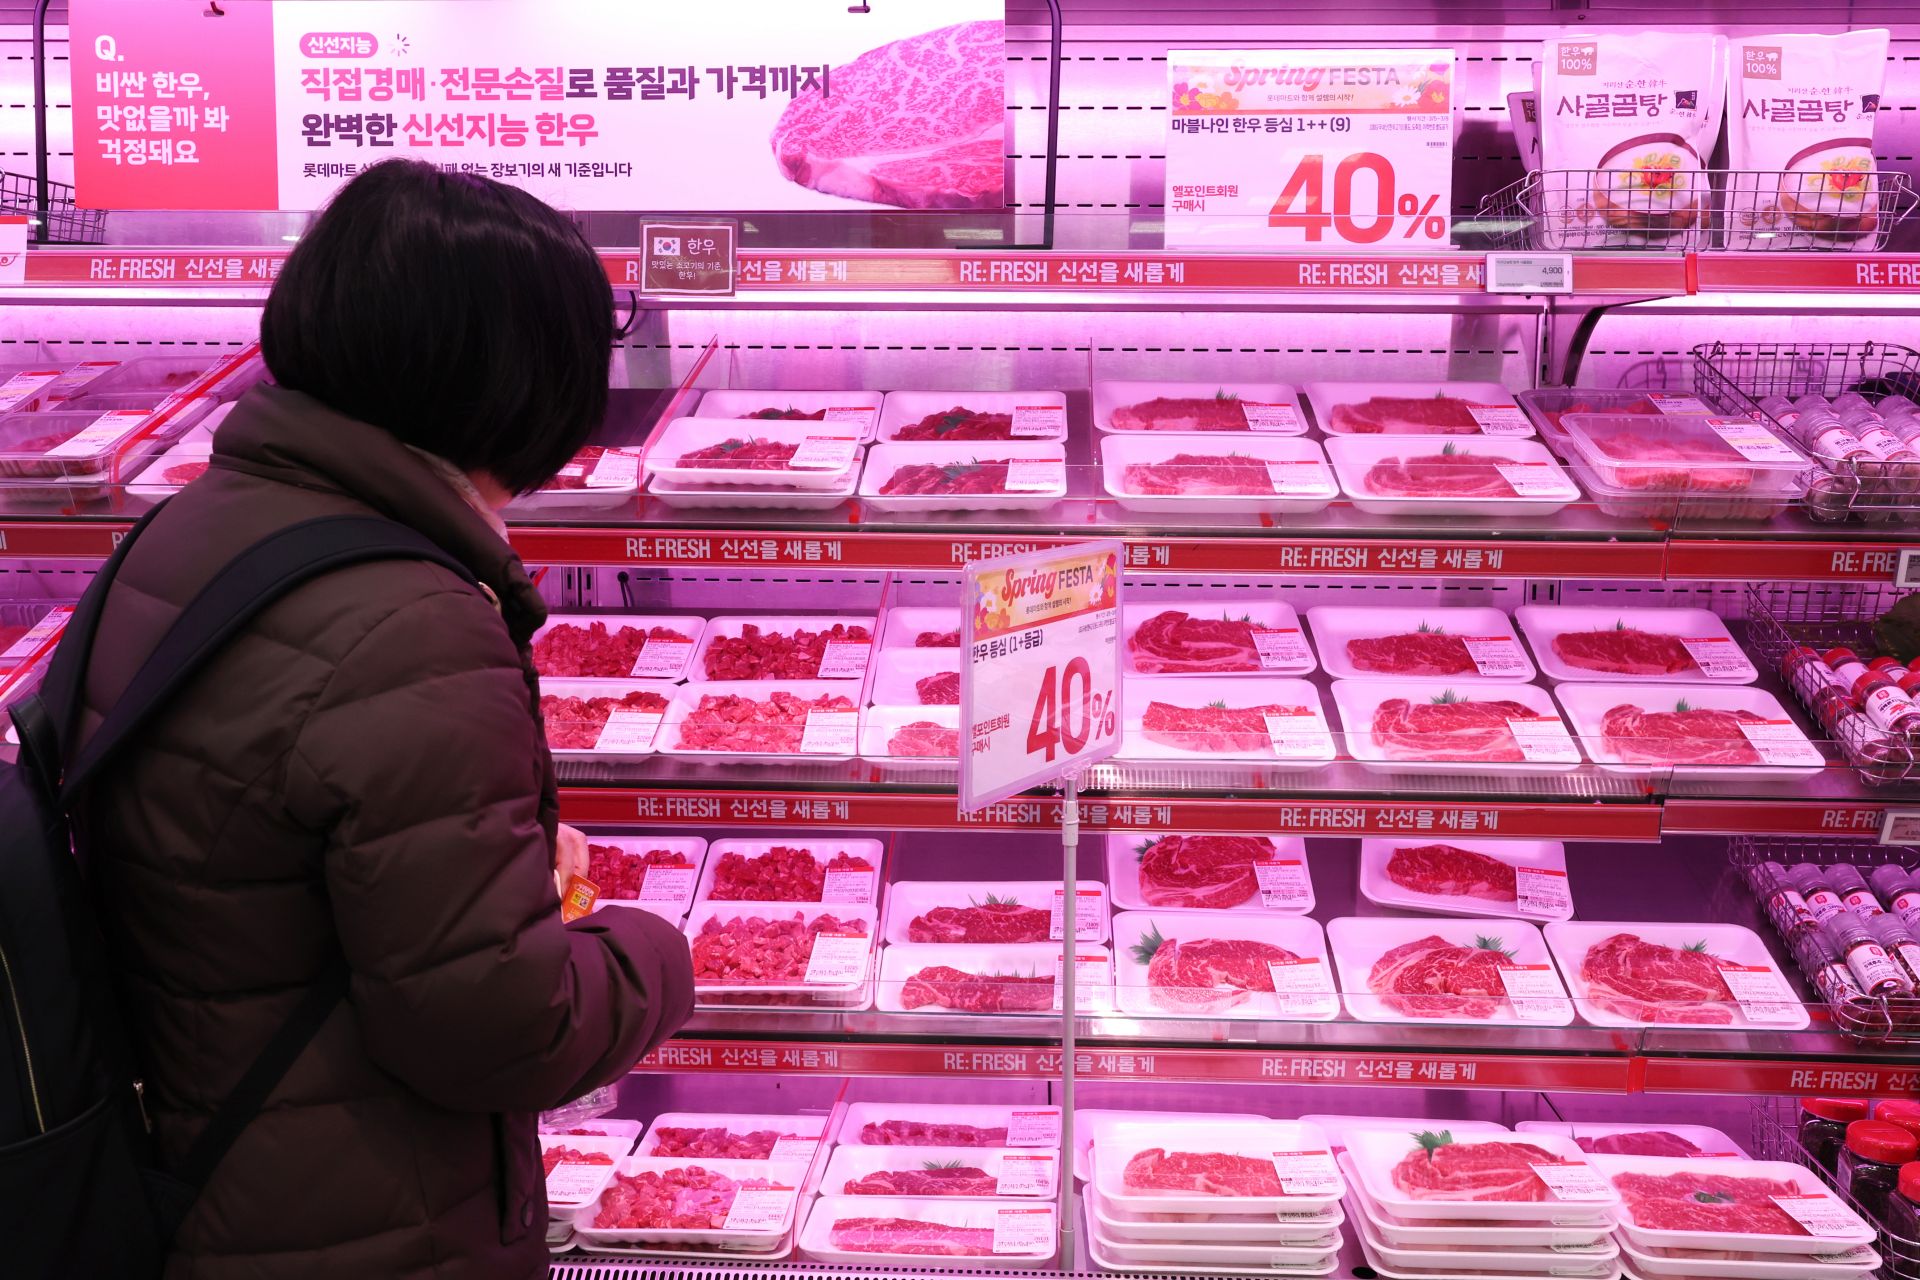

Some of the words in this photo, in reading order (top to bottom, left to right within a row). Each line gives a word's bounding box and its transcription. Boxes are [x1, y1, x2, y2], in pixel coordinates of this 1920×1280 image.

[95, 35, 124, 61] Q.
[308, 36, 372, 53] 신선지능
[1561, 46, 1579, 57] 한우
[1561, 59, 1592, 70] 100%
[1746, 50, 1764, 61] 한우
[1223, 64, 1326, 92] Spring
[1329, 67, 1400, 86] FESTA
[1746, 63, 1777, 75] 100%
[97, 71, 146, 97] 비싼
[152, 72, 210, 100] 한우,
[604, 66, 699, 100] 품질과
[706, 65, 830, 99] 가격까지
[1556, 93, 1668, 119] 사골곰탕
[1742, 98, 1854, 123] 사골곰탕
[97, 105, 199, 132] 맛없을까
[204, 106, 229, 132] 봐
[1172, 118, 1229, 133] 마블나인
[1233, 118, 1261, 132] 한우
[1265, 118, 1293, 133] 등심
[1297, 118, 1327, 131] 1++
[1331, 117, 1351, 132] (9)
[302, 113, 397, 147] 완벽한
[403, 113, 529, 147] 신선지능
[535, 113, 598, 147] 한우
[99, 139, 200, 165] 걱정돼요
[303, 163, 356, 177] 롯데마트
[491, 163, 544, 177] 장보기의
[548, 163, 560, 177] 새
[565, 163, 632, 177] 기준입니다
[1172, 185, 1239, 198] 엘포인트회원
[1269, 152, 1446, 243] 40%
[1172, 200, 1205, 212] 구매시
[688, 238, 716, 255] 한우
[120, 259, 175, 279] FRESH
[185, 259, 243, 279] 신선을
[248, 258, 285, 279] 새롭
[736, 261, 783, 282] 선을
[787, 261, 847, 283] 새롭게
[991, 261, 1047, 282] FRESH
[1058, 262, 1119, 283] 신선을
[1124, 262, 1184, 283] 새롭게
[1330, 264, 1387, 285] FRESH
[1399, 264, 1460, 285] 신선을
[1888, 264, 1920, 285] FRE
[656, 538, 711, 559] FRESH
[720, 540, 778, 560] 신선을
[784, 540, 841, 561] 새롭게
[1123, 545, 1169, 566] 롭게
[1310, 547, 1367, 567] FRESH
[1378, 549, 1438, 568] 신선을
[1442, 549, 1502, 570] 새롭게
[1862, 552, 1896, 572] FRE
[1001, 568, 1057, 605] Spring
[1058, 565, 1094, 590] FESTA
[990, 638, 1007, 659] 등심
[1009, 629, 1044, 654] (1+등급)
[1027, 656, 1115, 762] 40%
[666, 798, 721, 817] FRESH
[730, 799, 787, 818] 신선을
[792, 800, 848, 819] 새롭게
[986, 804, 1040, 823] FRESH
[1113, 805, 1171, 825] 새롭게
[1309, 808, 1366, 827] FRESH
[1376, 809, 1435, 829] 신선을
[1440, 810, 1498, 829] 새롭게
[658, 1048, 712, 1065] FRESH
[721, 1049, 777, 1067] 신선을
[783, 1049, 838, 1068] 새롭게
[973, 1053, 1026, 1071] FRESH
[1098, 1056, 1155, 1073] 새롭게
[1291, 1059, 1345, 1077] FRESH
[1355, 1060, 1413, 1079] 신선을
[1418, 1062, 1476, 1080] 새롭게
[1820, 1071, 1878, 1089] FRESH
[1888, 1073, 1920, 1091] 신선
